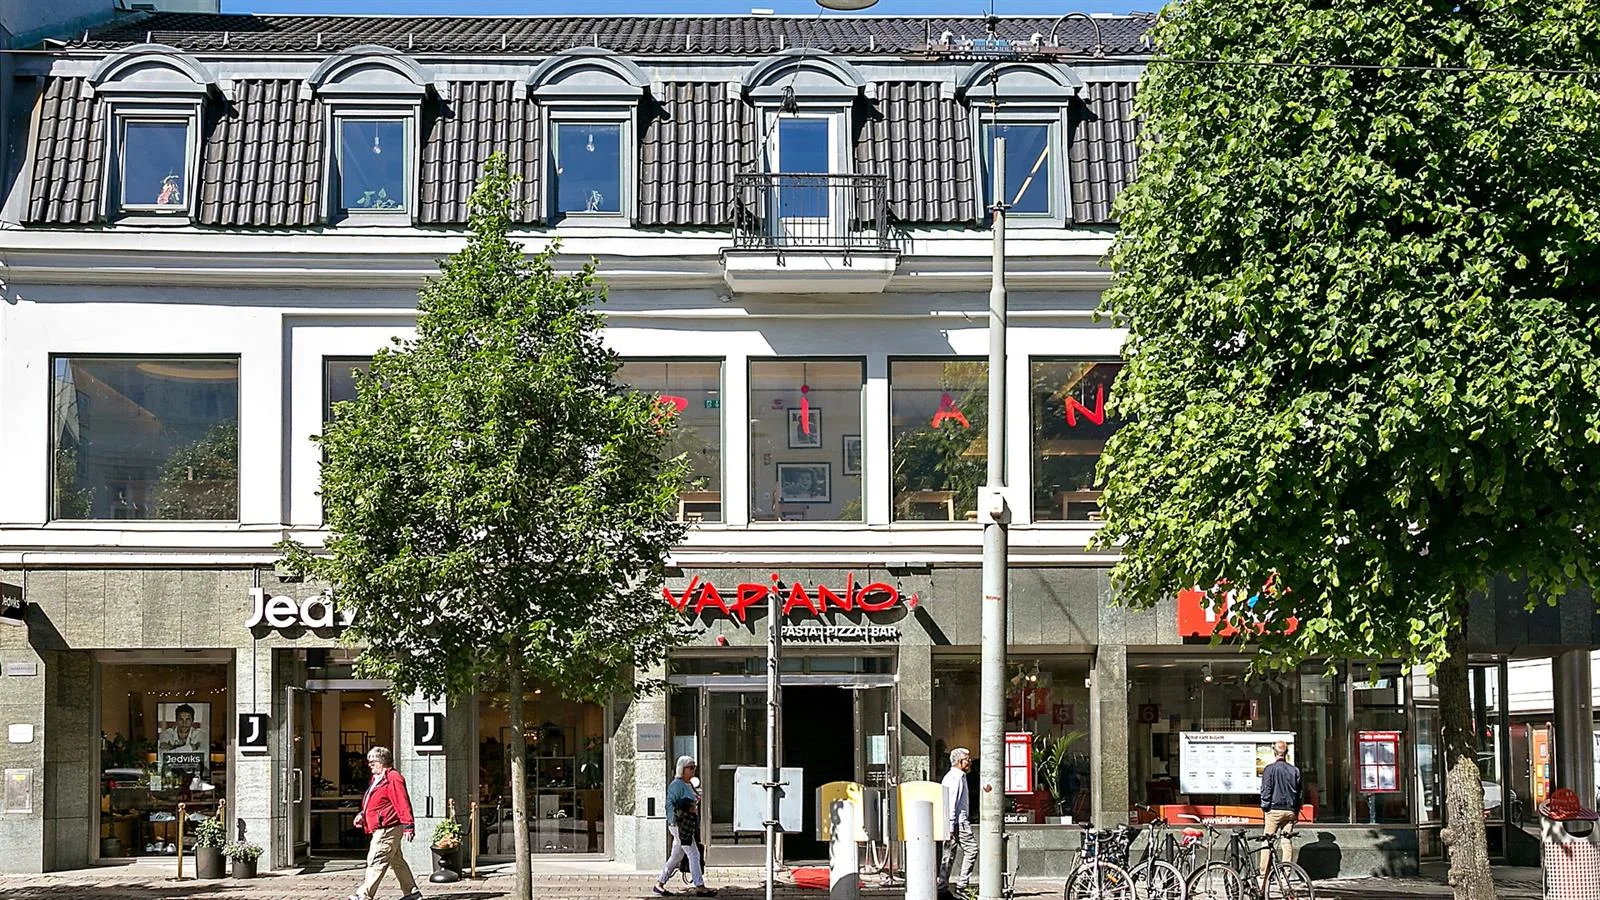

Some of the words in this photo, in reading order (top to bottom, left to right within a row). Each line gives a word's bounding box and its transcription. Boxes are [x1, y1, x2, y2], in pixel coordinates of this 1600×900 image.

[1065, 383, 1104, 428] N
[781, 626, 818, 637] PASTA
[827, 626, 862, 637] PIZZA
[871, 626, 897, 637] BAR
[246, 716, 259, 743] J
[422, 715, 435, 743] J
[166, 755, 201, 764] Jedviks
[1004, 814, 1028, 823] cket.se
